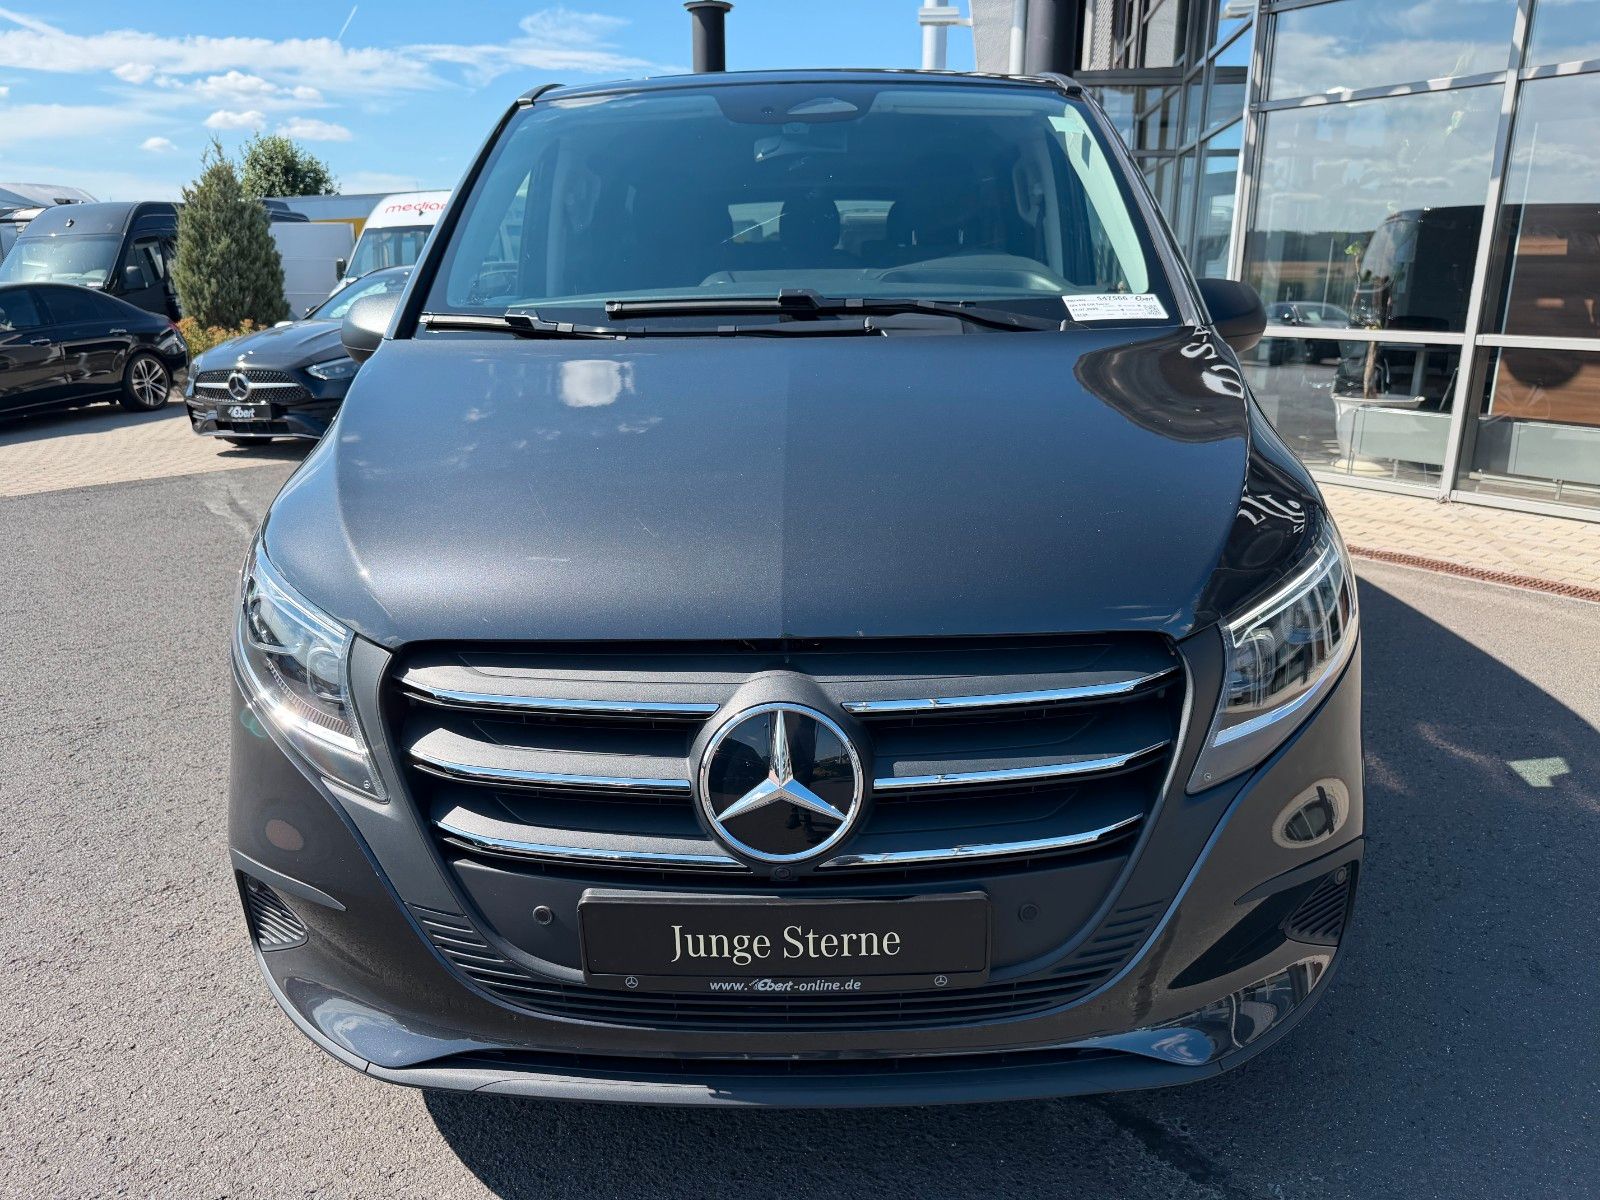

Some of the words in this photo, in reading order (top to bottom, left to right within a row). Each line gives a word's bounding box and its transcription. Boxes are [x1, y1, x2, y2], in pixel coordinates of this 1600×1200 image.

[229, 406, 255, 418] Ebert
[671, 925, 771, 966] Junge
[783, 925, 901, 959] Sterne
[709, 978, 862, 992] www.Ebert-online.de
